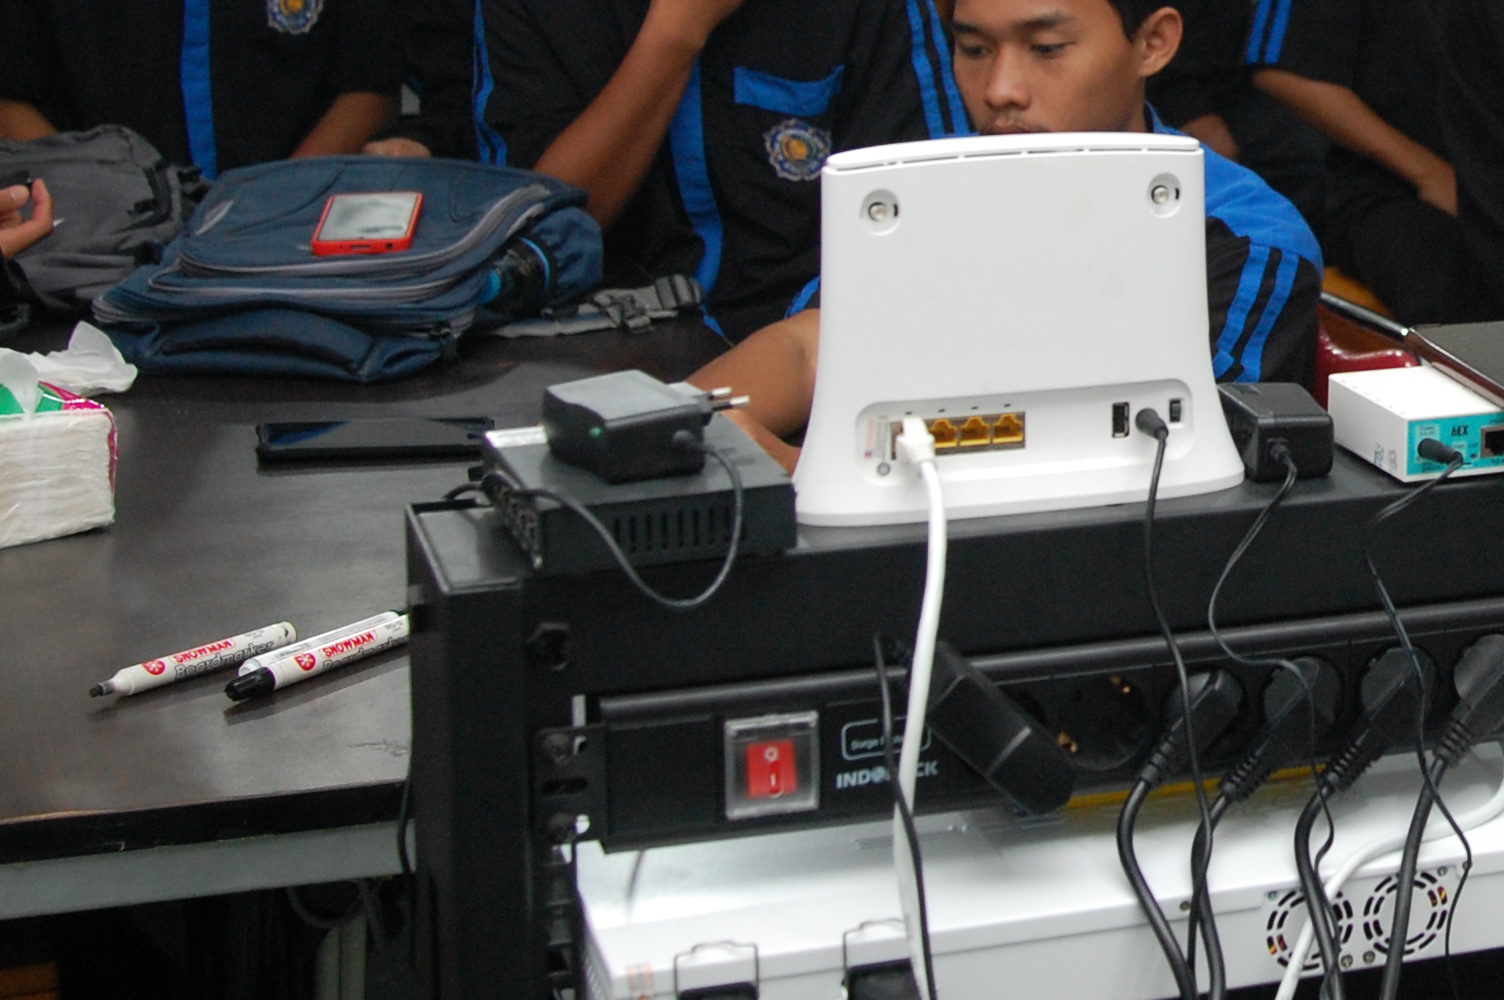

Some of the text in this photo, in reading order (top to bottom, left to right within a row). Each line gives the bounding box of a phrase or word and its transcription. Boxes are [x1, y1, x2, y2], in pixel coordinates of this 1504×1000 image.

[173, 640, 233, 663] SNOWMAN
[323, 631, 375, 658] SNOWMAN
[836, 760, 938, 789] INDOCK
